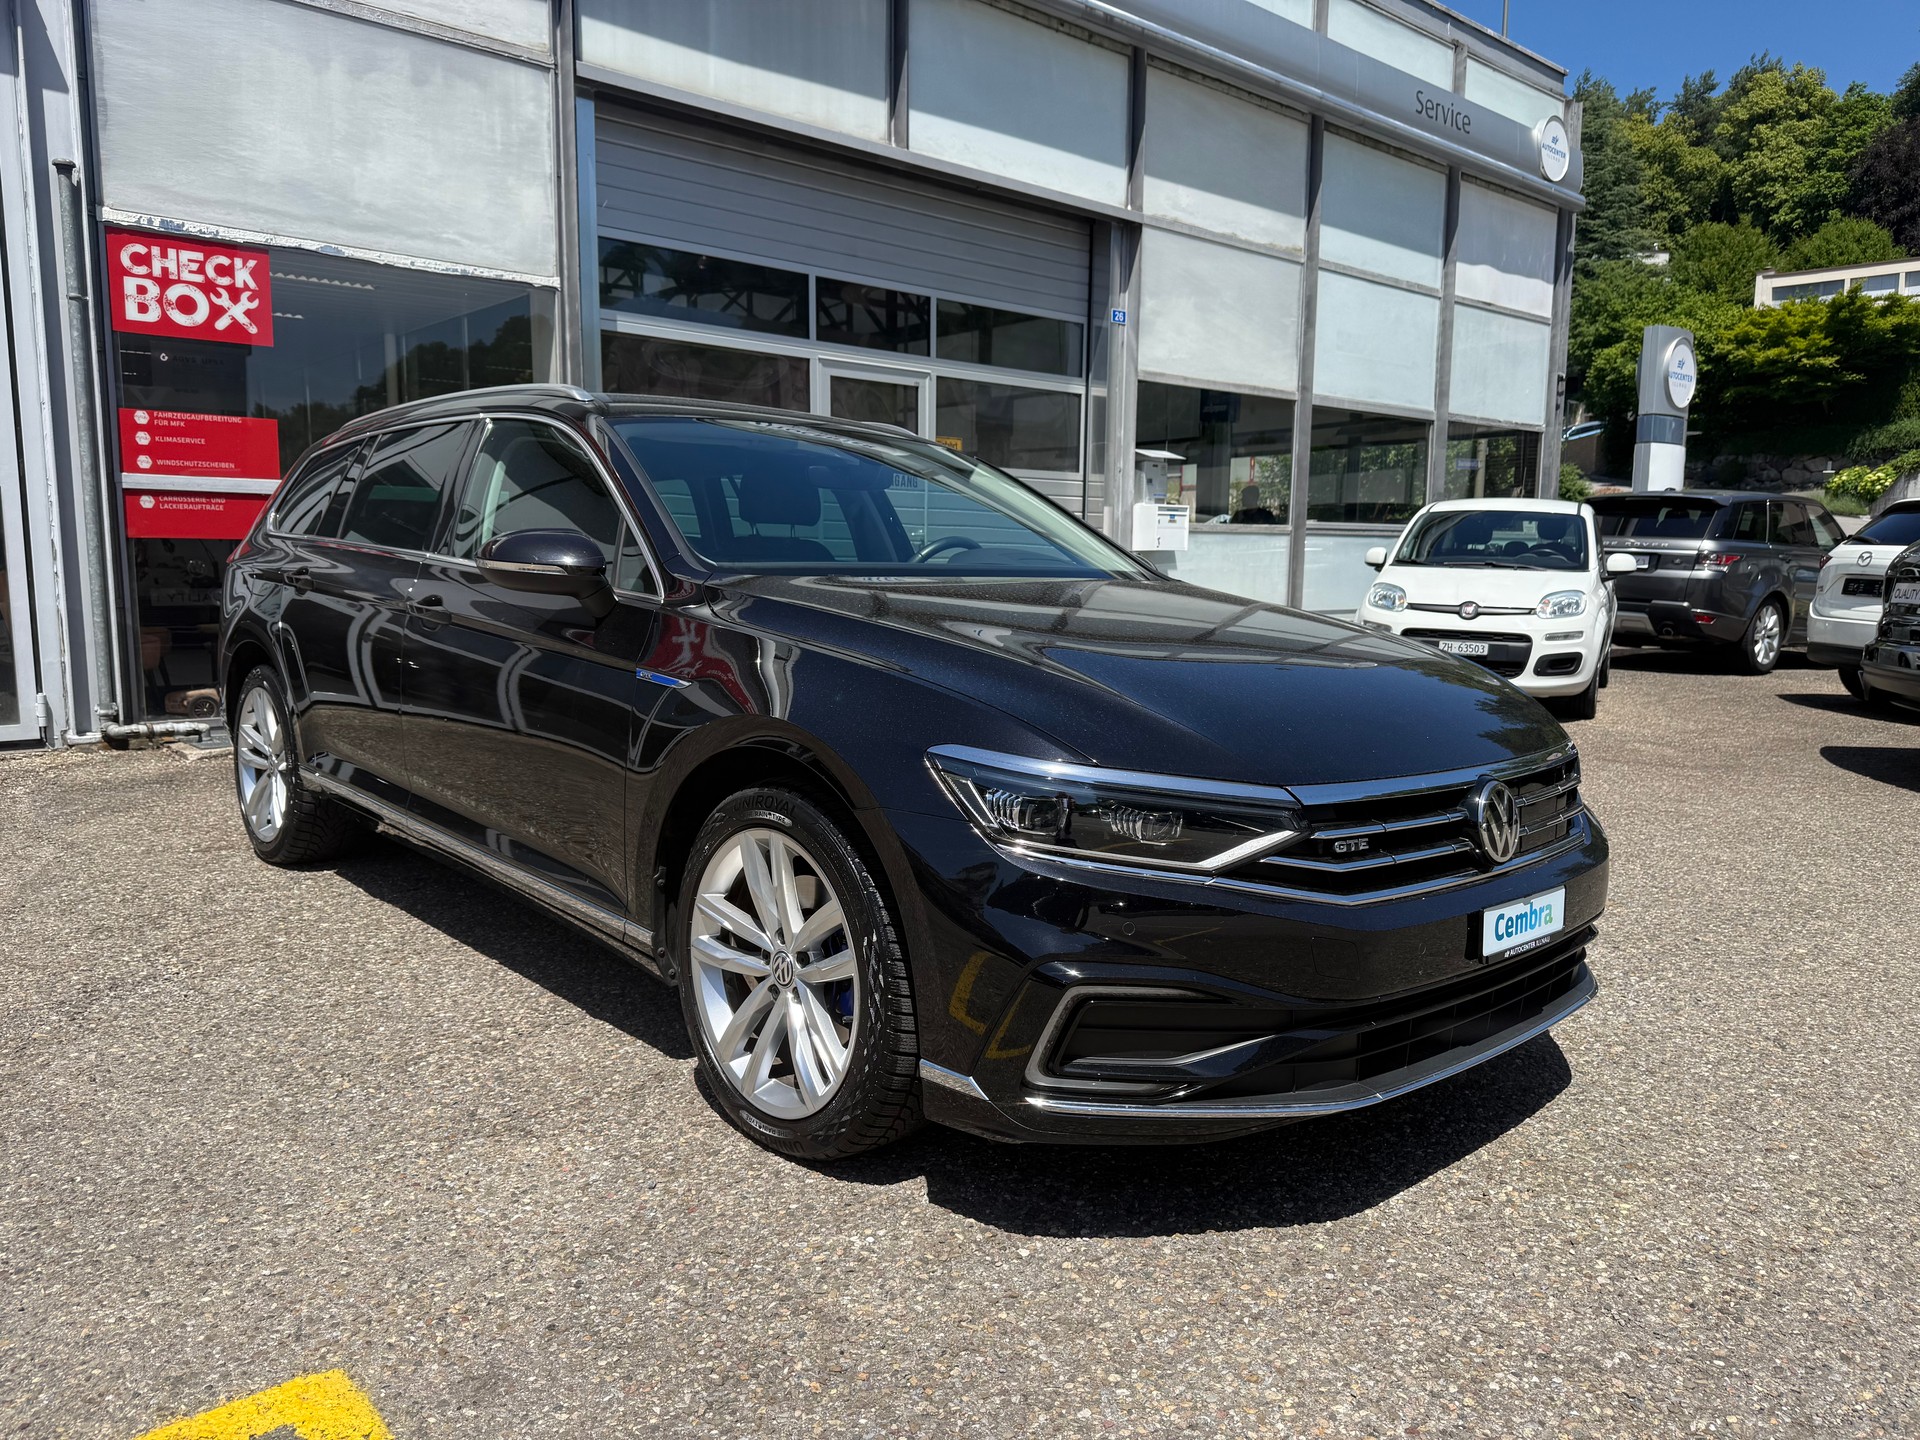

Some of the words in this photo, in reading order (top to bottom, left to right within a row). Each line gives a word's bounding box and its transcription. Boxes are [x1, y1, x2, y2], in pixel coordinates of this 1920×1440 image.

[1415, 90, 1471, 134] Service
[1541, 142, 1566, 159] AUTOCENTER
[120, 243, 259, 290] CHECK
[123, 276, 260, 334] BOX
[1114, 311, 1124, 322] 26
[153, 411, 242, 424] FAHRZEUGAUFBEREITUNG
[155, 436, 206, 445] KLIMASERVICE
[156, 459, 235, 469] WINDSCHUTZSCHEIBEN
[159, 503, 224, 511] LACKIERAUFTRÄGE
[1894, 589, 1919, 600] QUALITY
[1457, 643, 1485, 654] 63503
[733, 795, 797, 819] UNIROYAL
[755, 810, 768, 818] RAIN
[1333, 838, 1370, 853] GTE
[1494, 901, 1554, 942] Cembra
[1510, 941, 1536, 956] AUTOCENTER
[1536, 935, 1551, 946] ILLNAU
